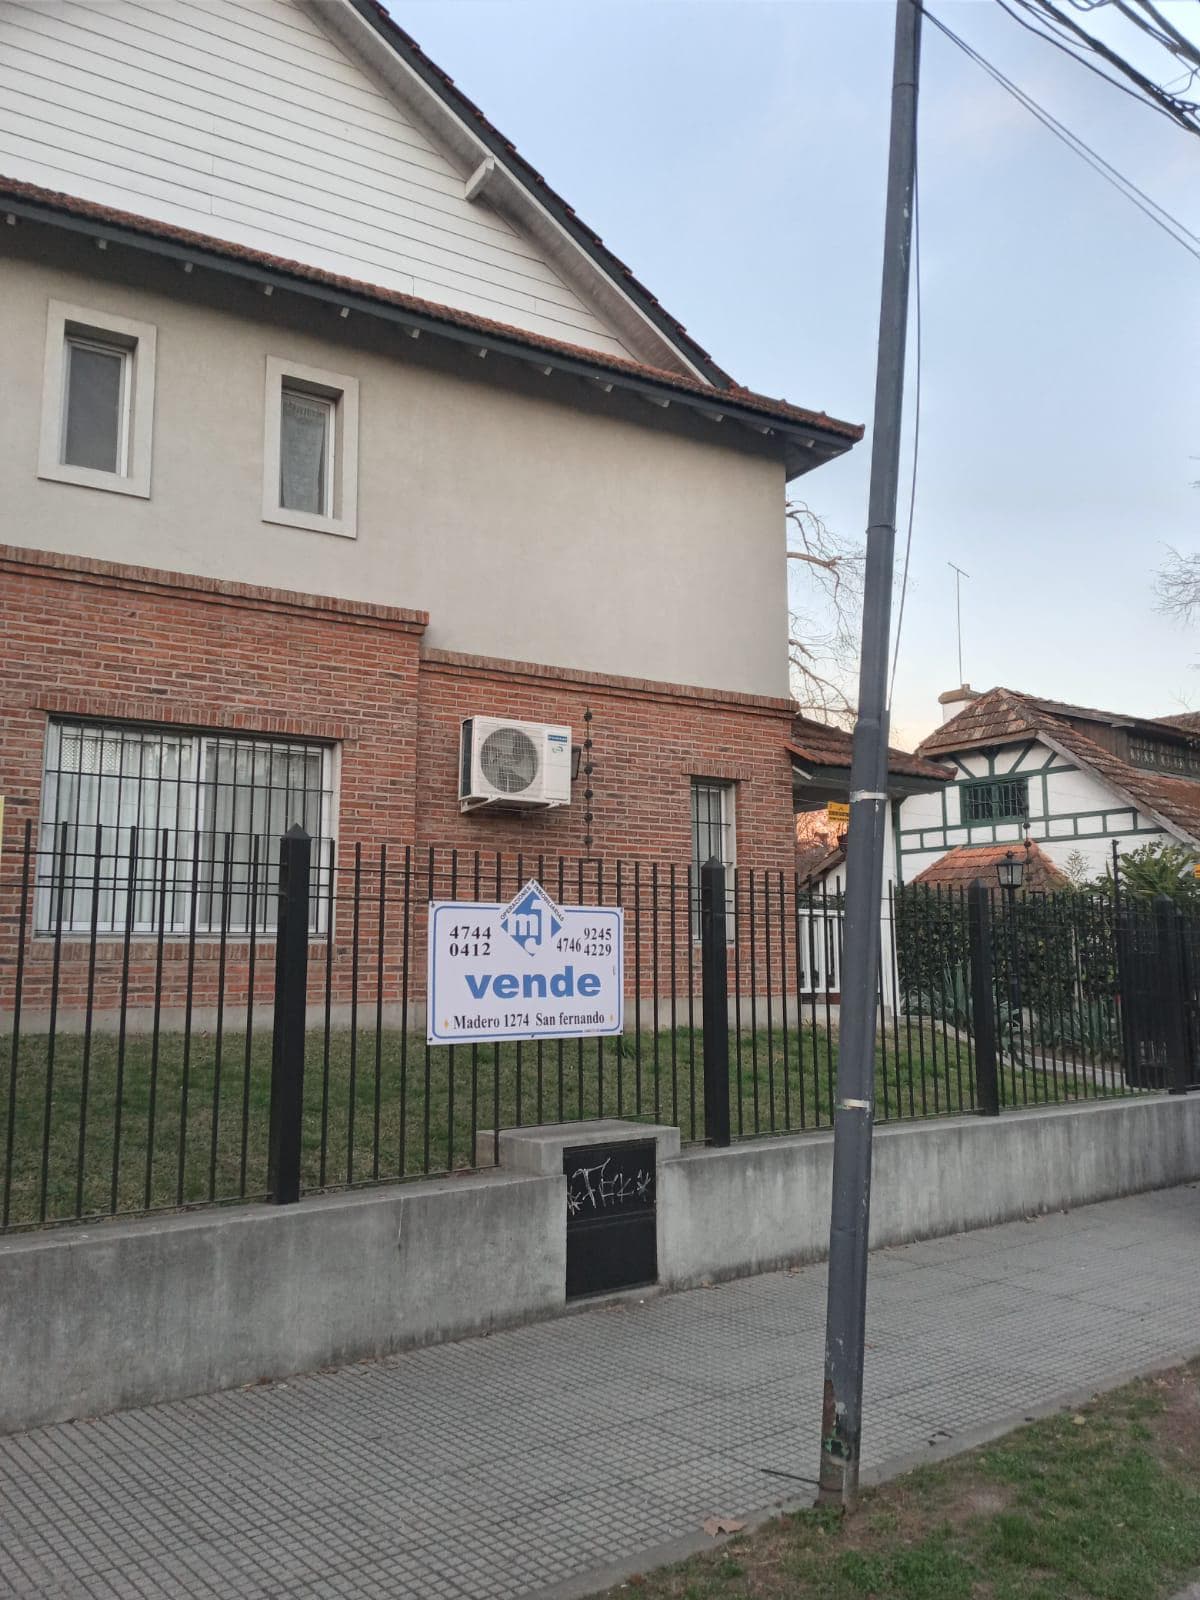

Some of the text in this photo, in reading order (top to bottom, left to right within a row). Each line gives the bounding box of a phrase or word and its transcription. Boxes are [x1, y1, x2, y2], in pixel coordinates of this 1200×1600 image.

[500, 884, 565, 922] OPERACIONES INMOBILIARIAS
[449, 925, 491, 940] 4744
[583, 927, 612, 941] 9245
[449, 942, 491, 956] 0412
[556, 937, 582, 953] 4746
[583, 943, 612, 956] 4229
[464, 965, 602, 999] vende
[454, 1011, 605, 1029] Madero 1274 San fernando
